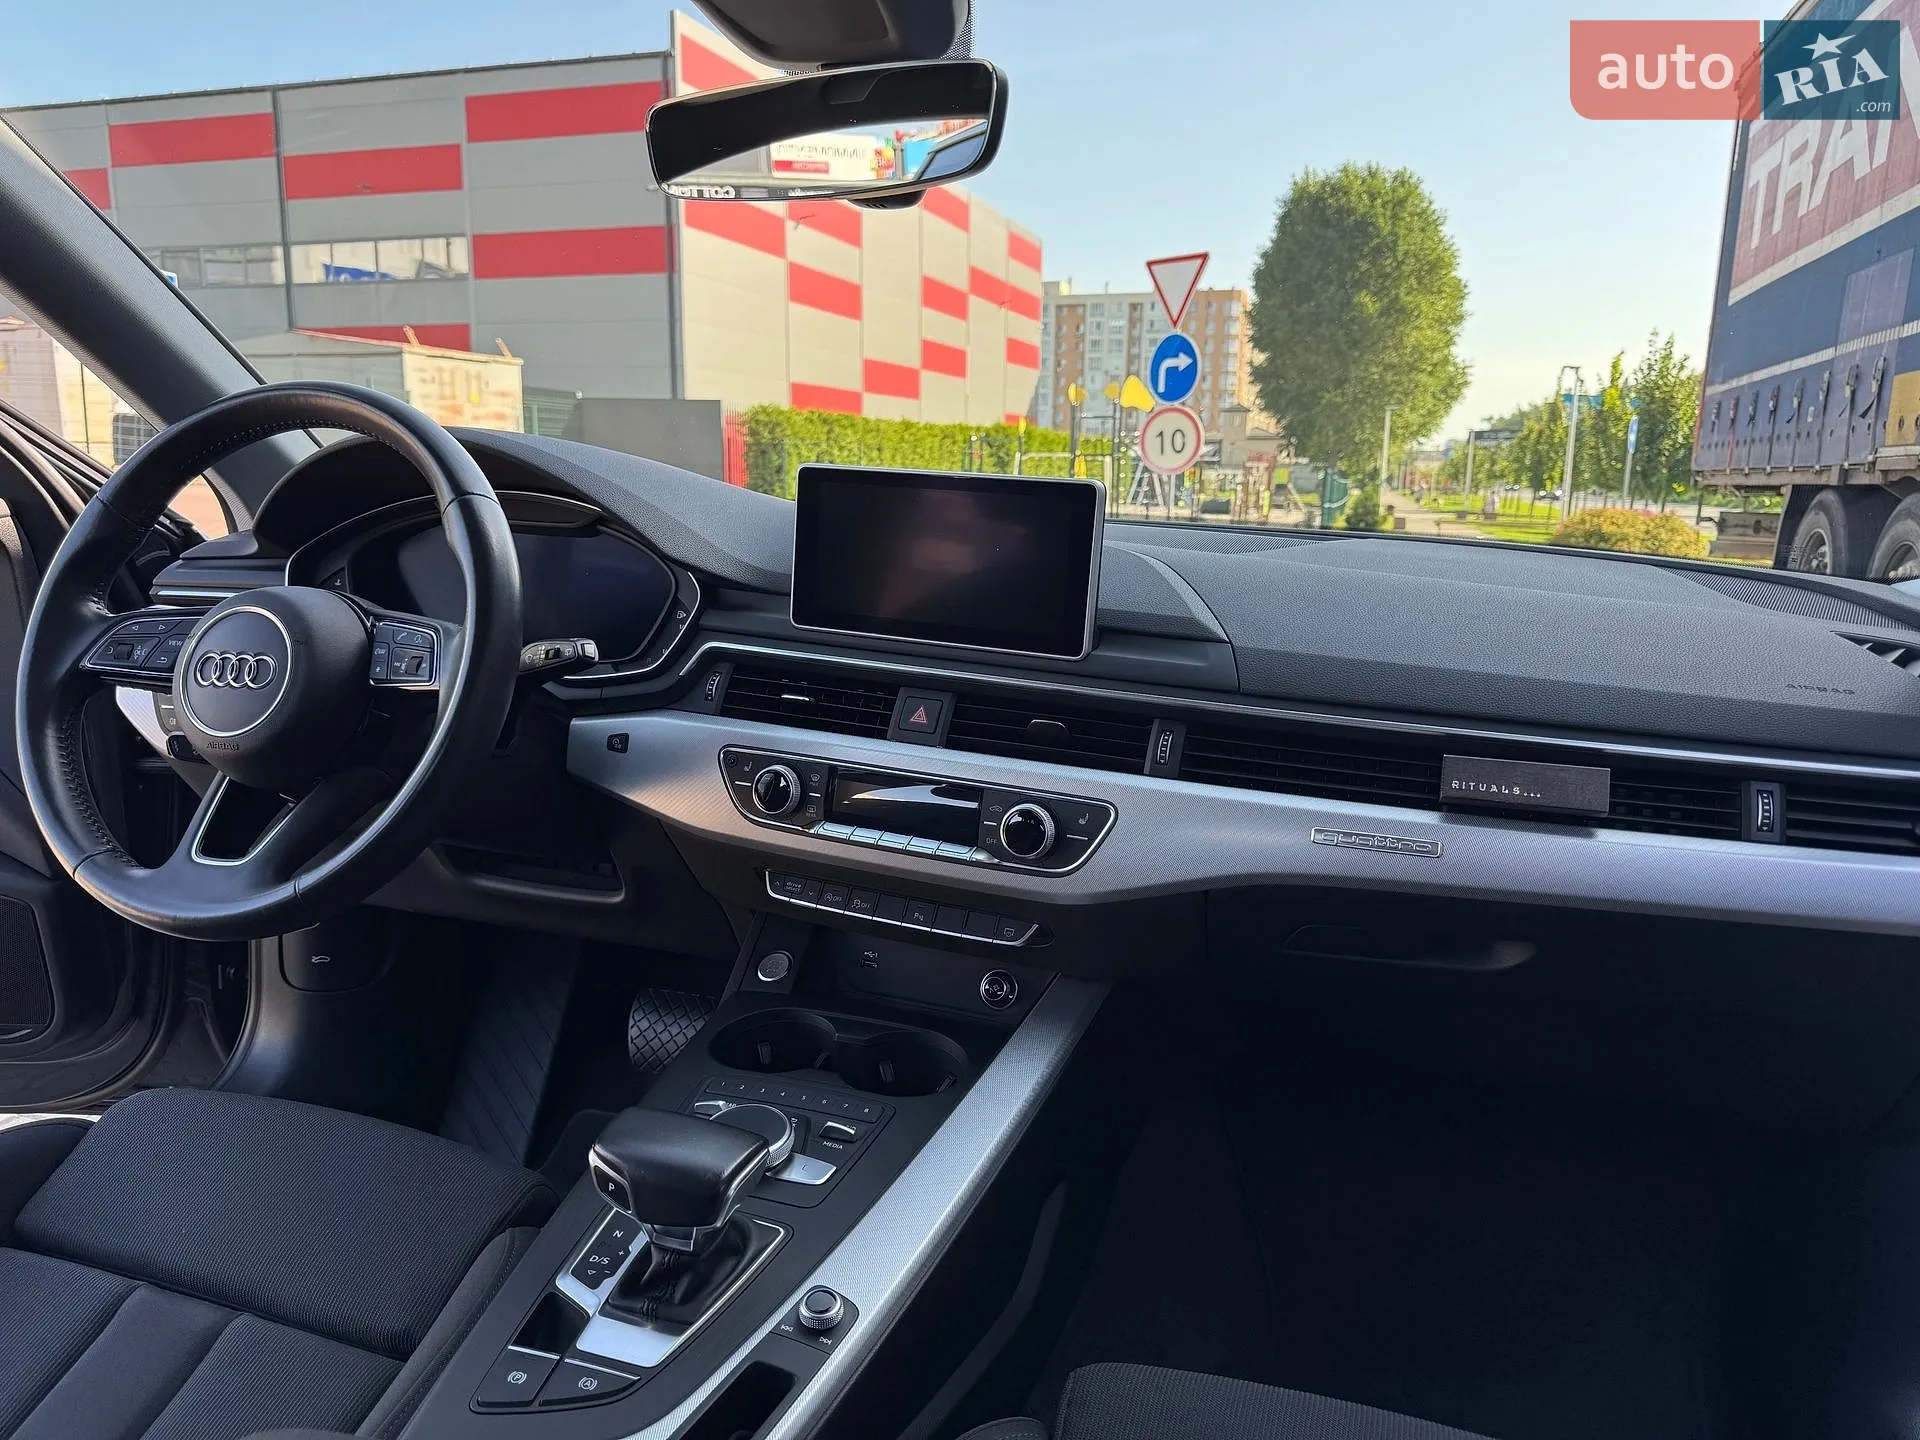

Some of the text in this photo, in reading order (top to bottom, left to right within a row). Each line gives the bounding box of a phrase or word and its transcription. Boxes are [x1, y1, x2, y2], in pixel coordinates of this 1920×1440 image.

[1155, 428, 1186, 456] 10
[1320, 831, 1433, 852] quattro
[822, 1141, 843, 1150] MEDIA
[608, 1182, 615, 1191] P
[613, 1230, 624, 1238] N
[589, 1255, 611, 1265] D/S
